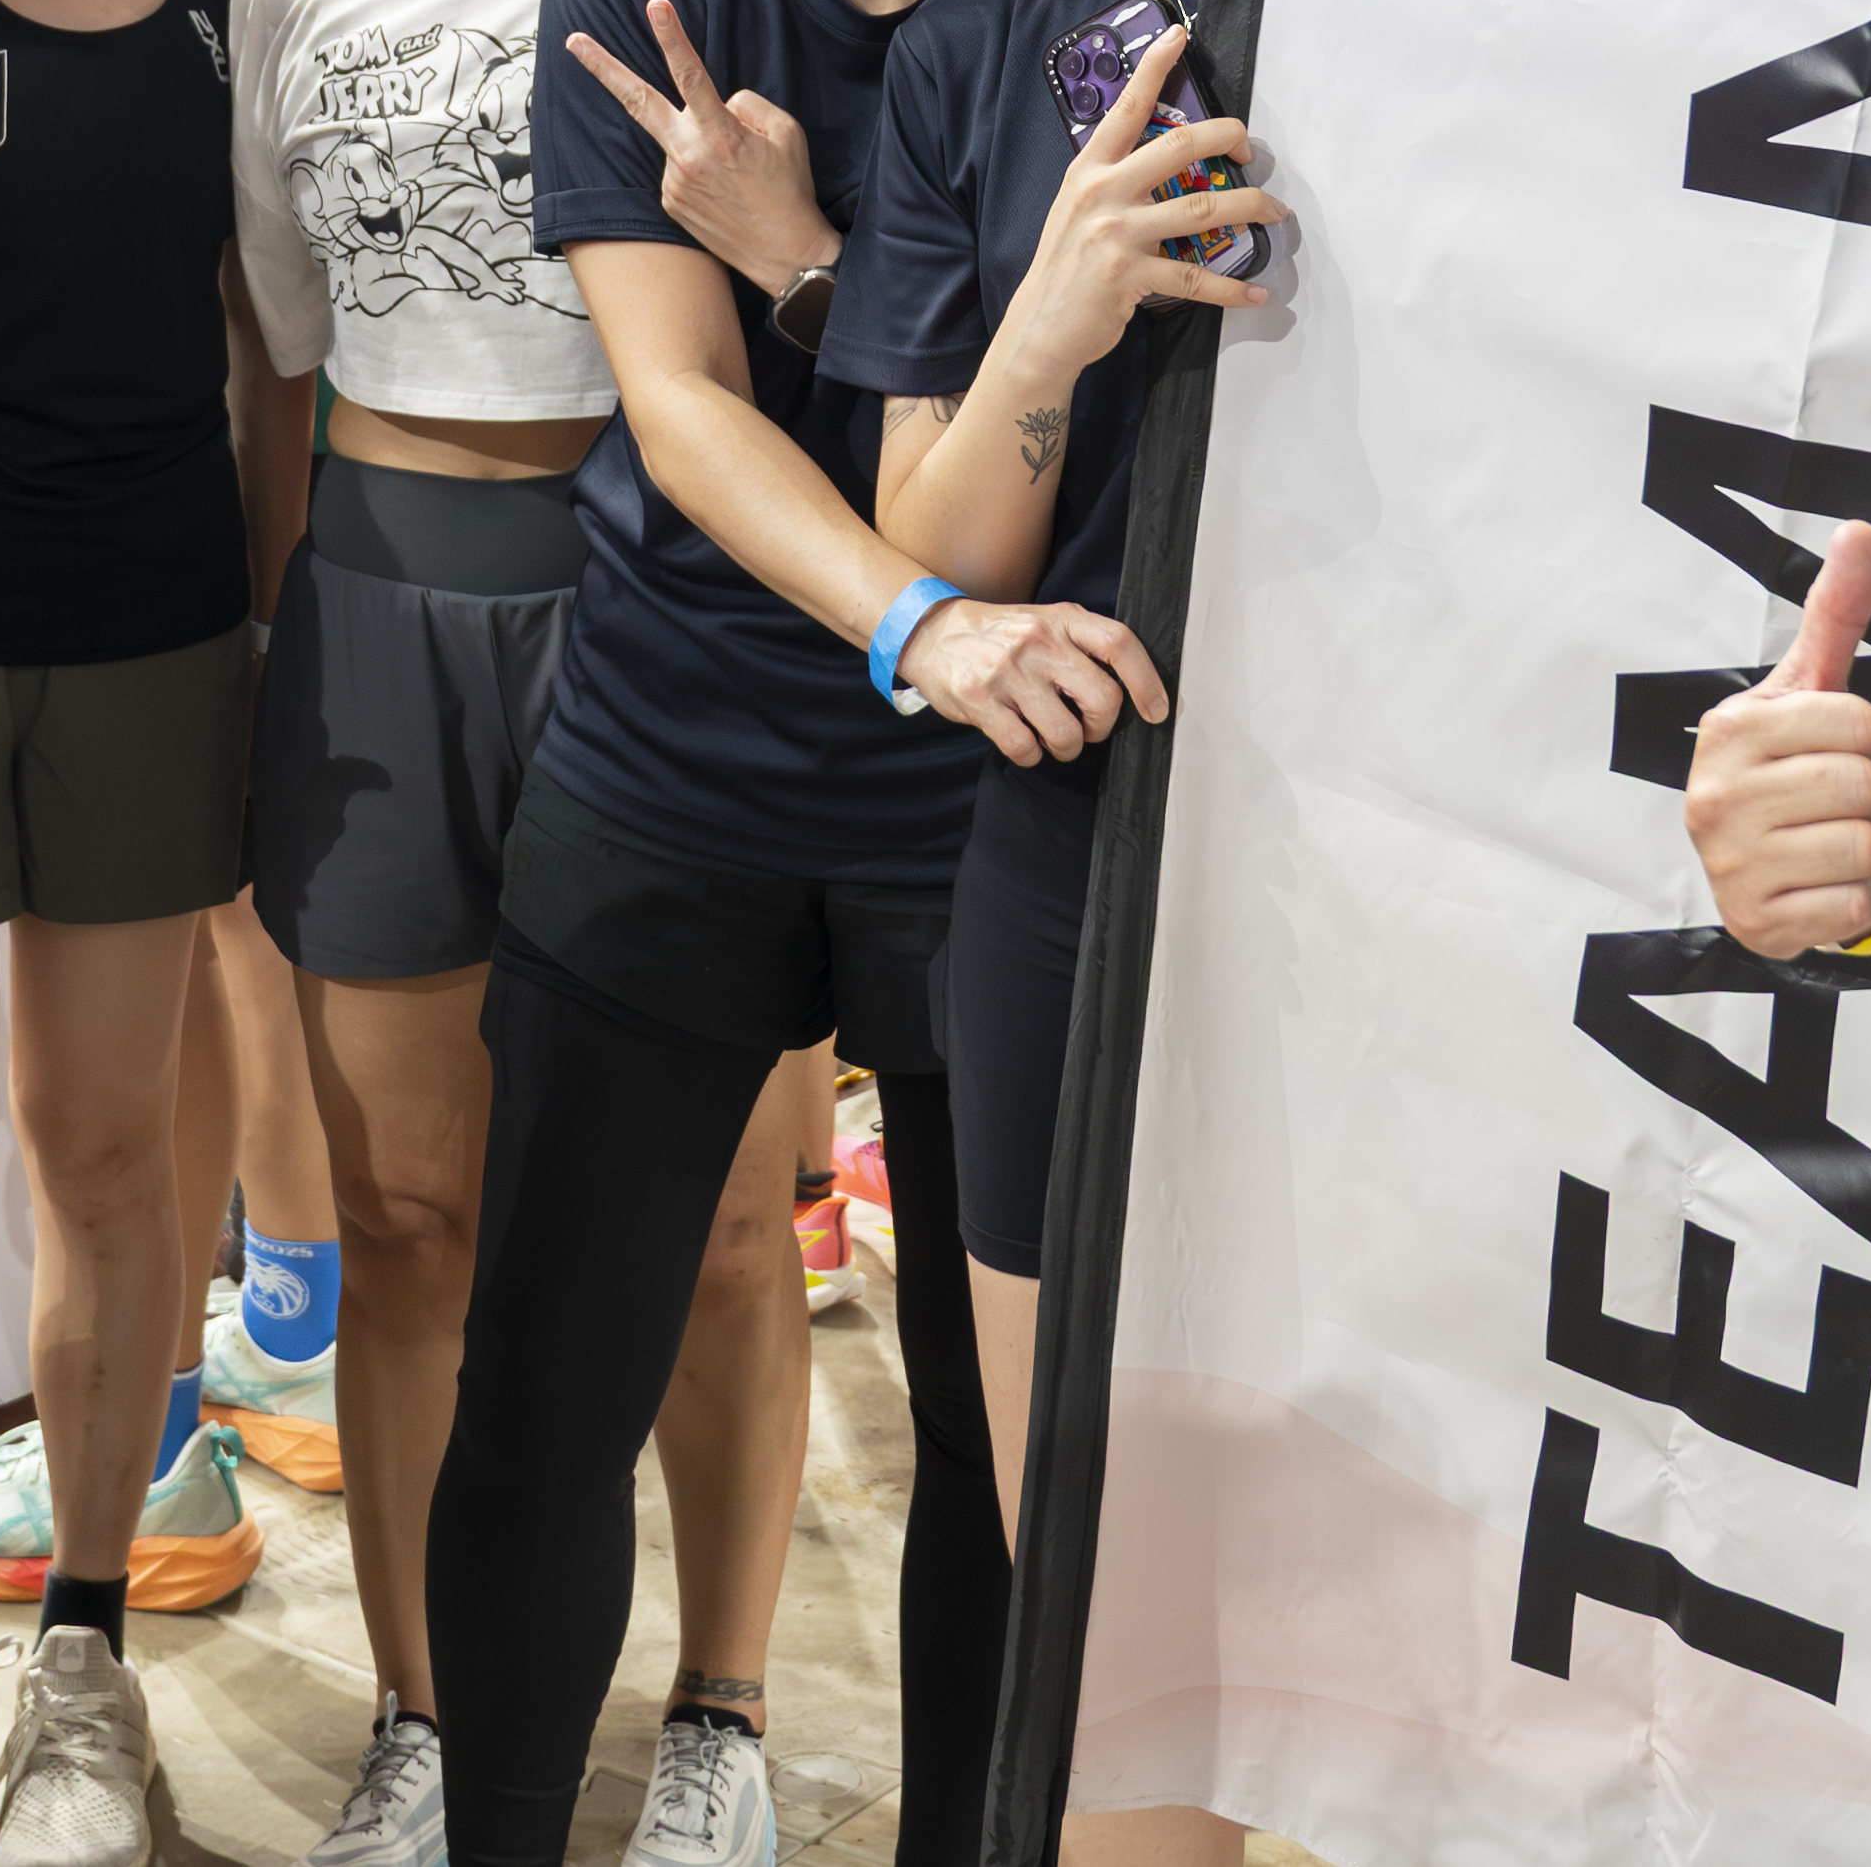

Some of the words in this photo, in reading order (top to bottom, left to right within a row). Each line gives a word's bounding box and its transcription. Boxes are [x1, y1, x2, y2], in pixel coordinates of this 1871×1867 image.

[314, 24, 392, 78] TOM
[394, 23, 443, 66] and
[308, 66, 437, 124] JERRY
